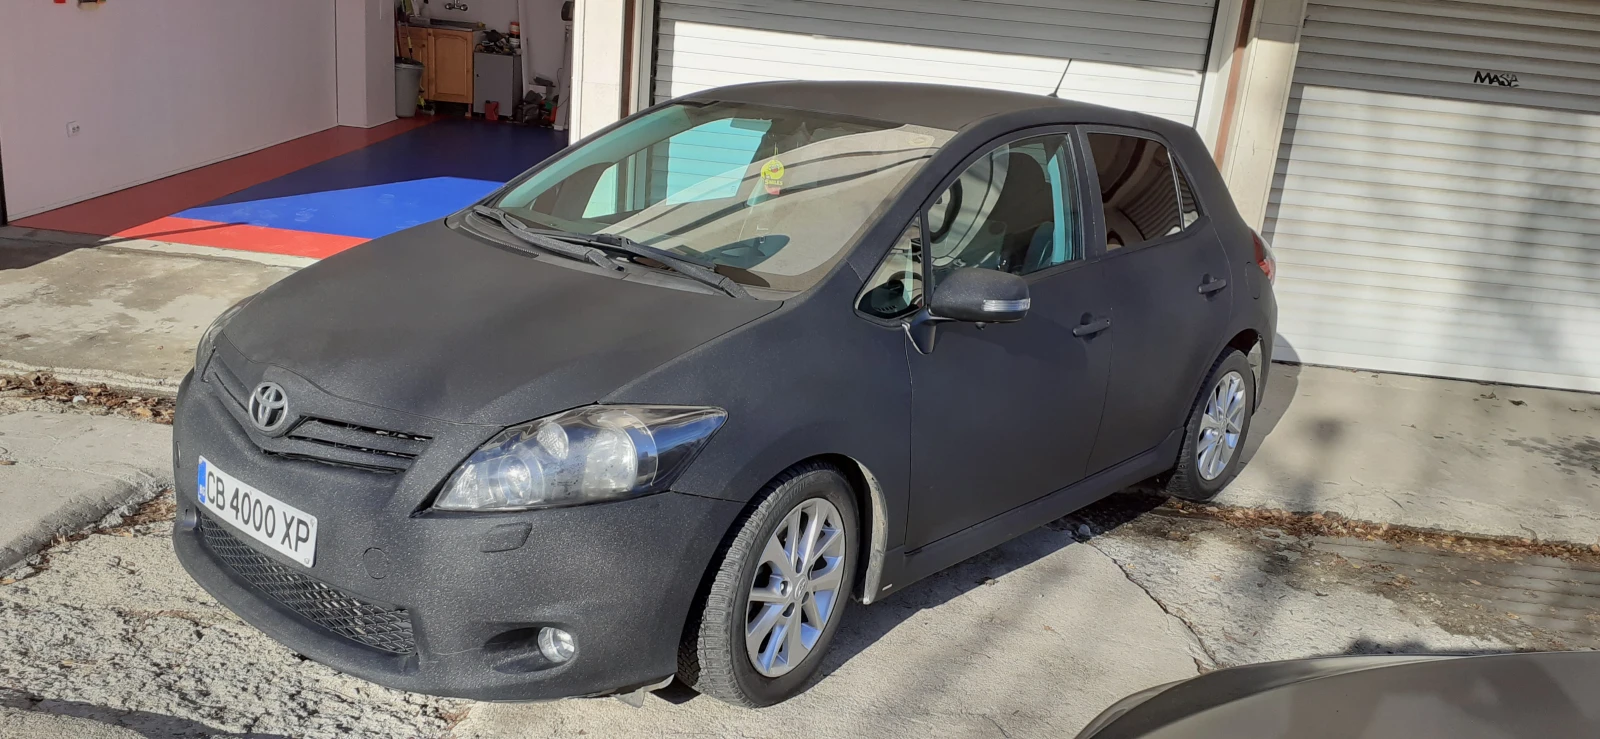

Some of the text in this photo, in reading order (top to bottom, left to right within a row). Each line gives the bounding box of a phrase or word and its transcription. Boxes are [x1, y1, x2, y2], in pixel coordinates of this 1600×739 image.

[207, 471, 310, 552] CB 4000 XP
